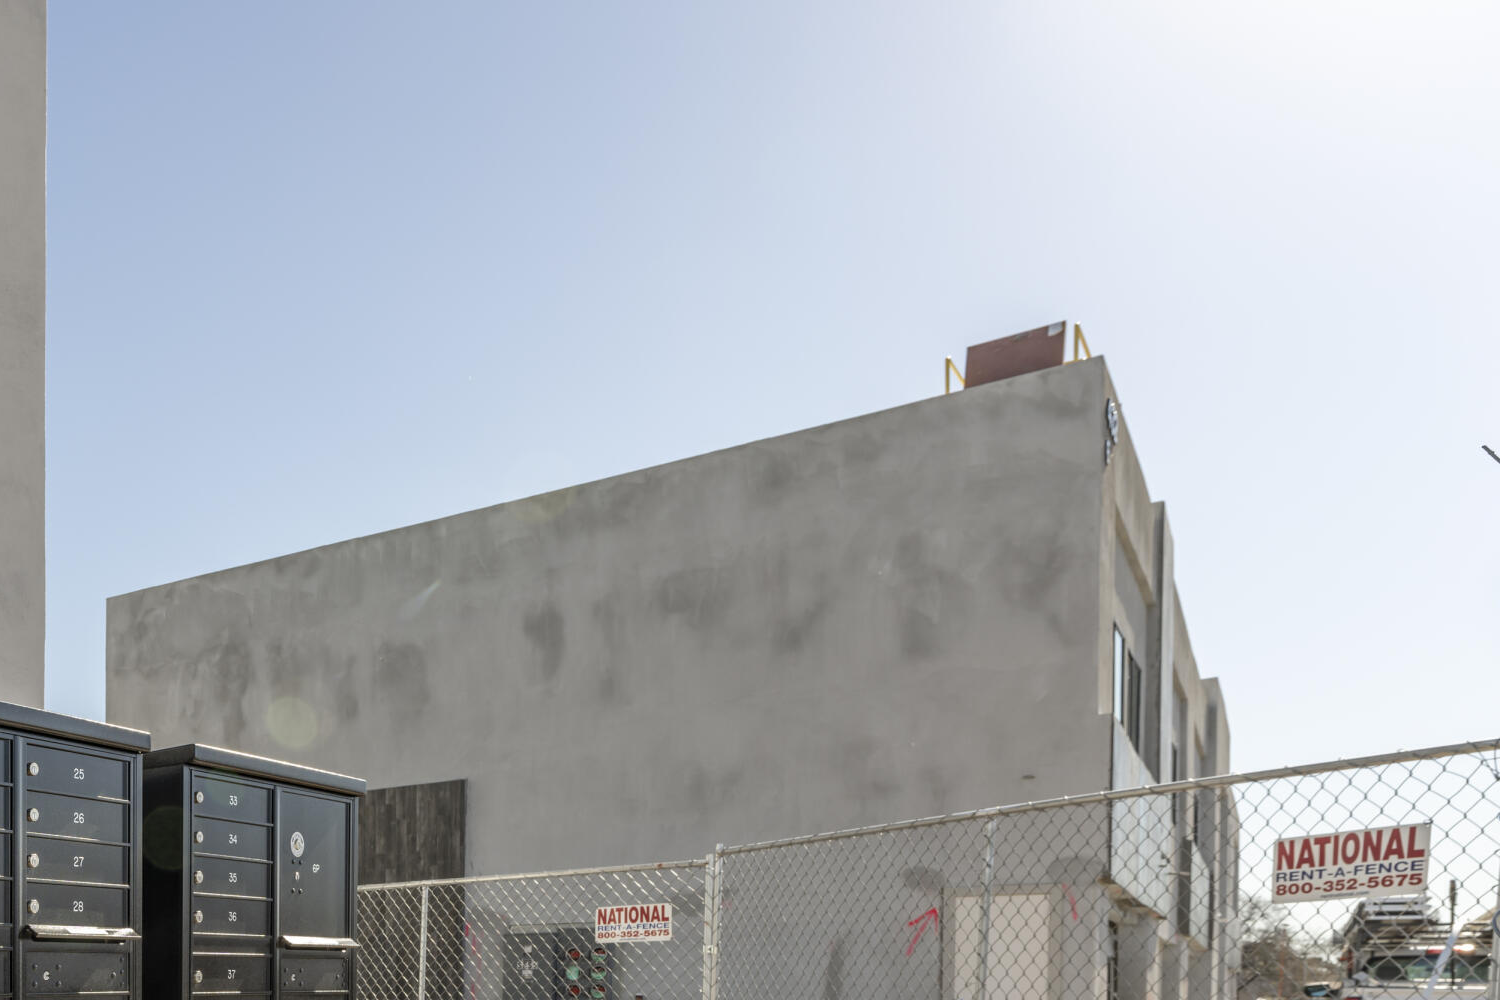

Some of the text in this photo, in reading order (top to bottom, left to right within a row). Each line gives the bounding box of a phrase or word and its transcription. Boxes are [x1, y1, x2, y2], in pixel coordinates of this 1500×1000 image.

[73, 767, 85, 781] 25
[73, 811, 85, 824] 26
[228, 833, 238, 845] 34
[1277, 826, 1425, 871] NATIONAL
[73, 855, 85, 868] 27
[228, 872, 238, 883] 35
[1275, 860, 1424, 882] RENT-A-FENCE
[1275, 873, 1423, 896] 800-352-5675
[73, 900, 84, 913] 28
[228, 911, 237, 922] 36
[597, 905, 670, 925] NATIONAL
[597, 922, 669, 931] RENT-A-FENCE
[597, 929, 669, 939] 800-352-5675
[227, 969, 236, 980] 37
